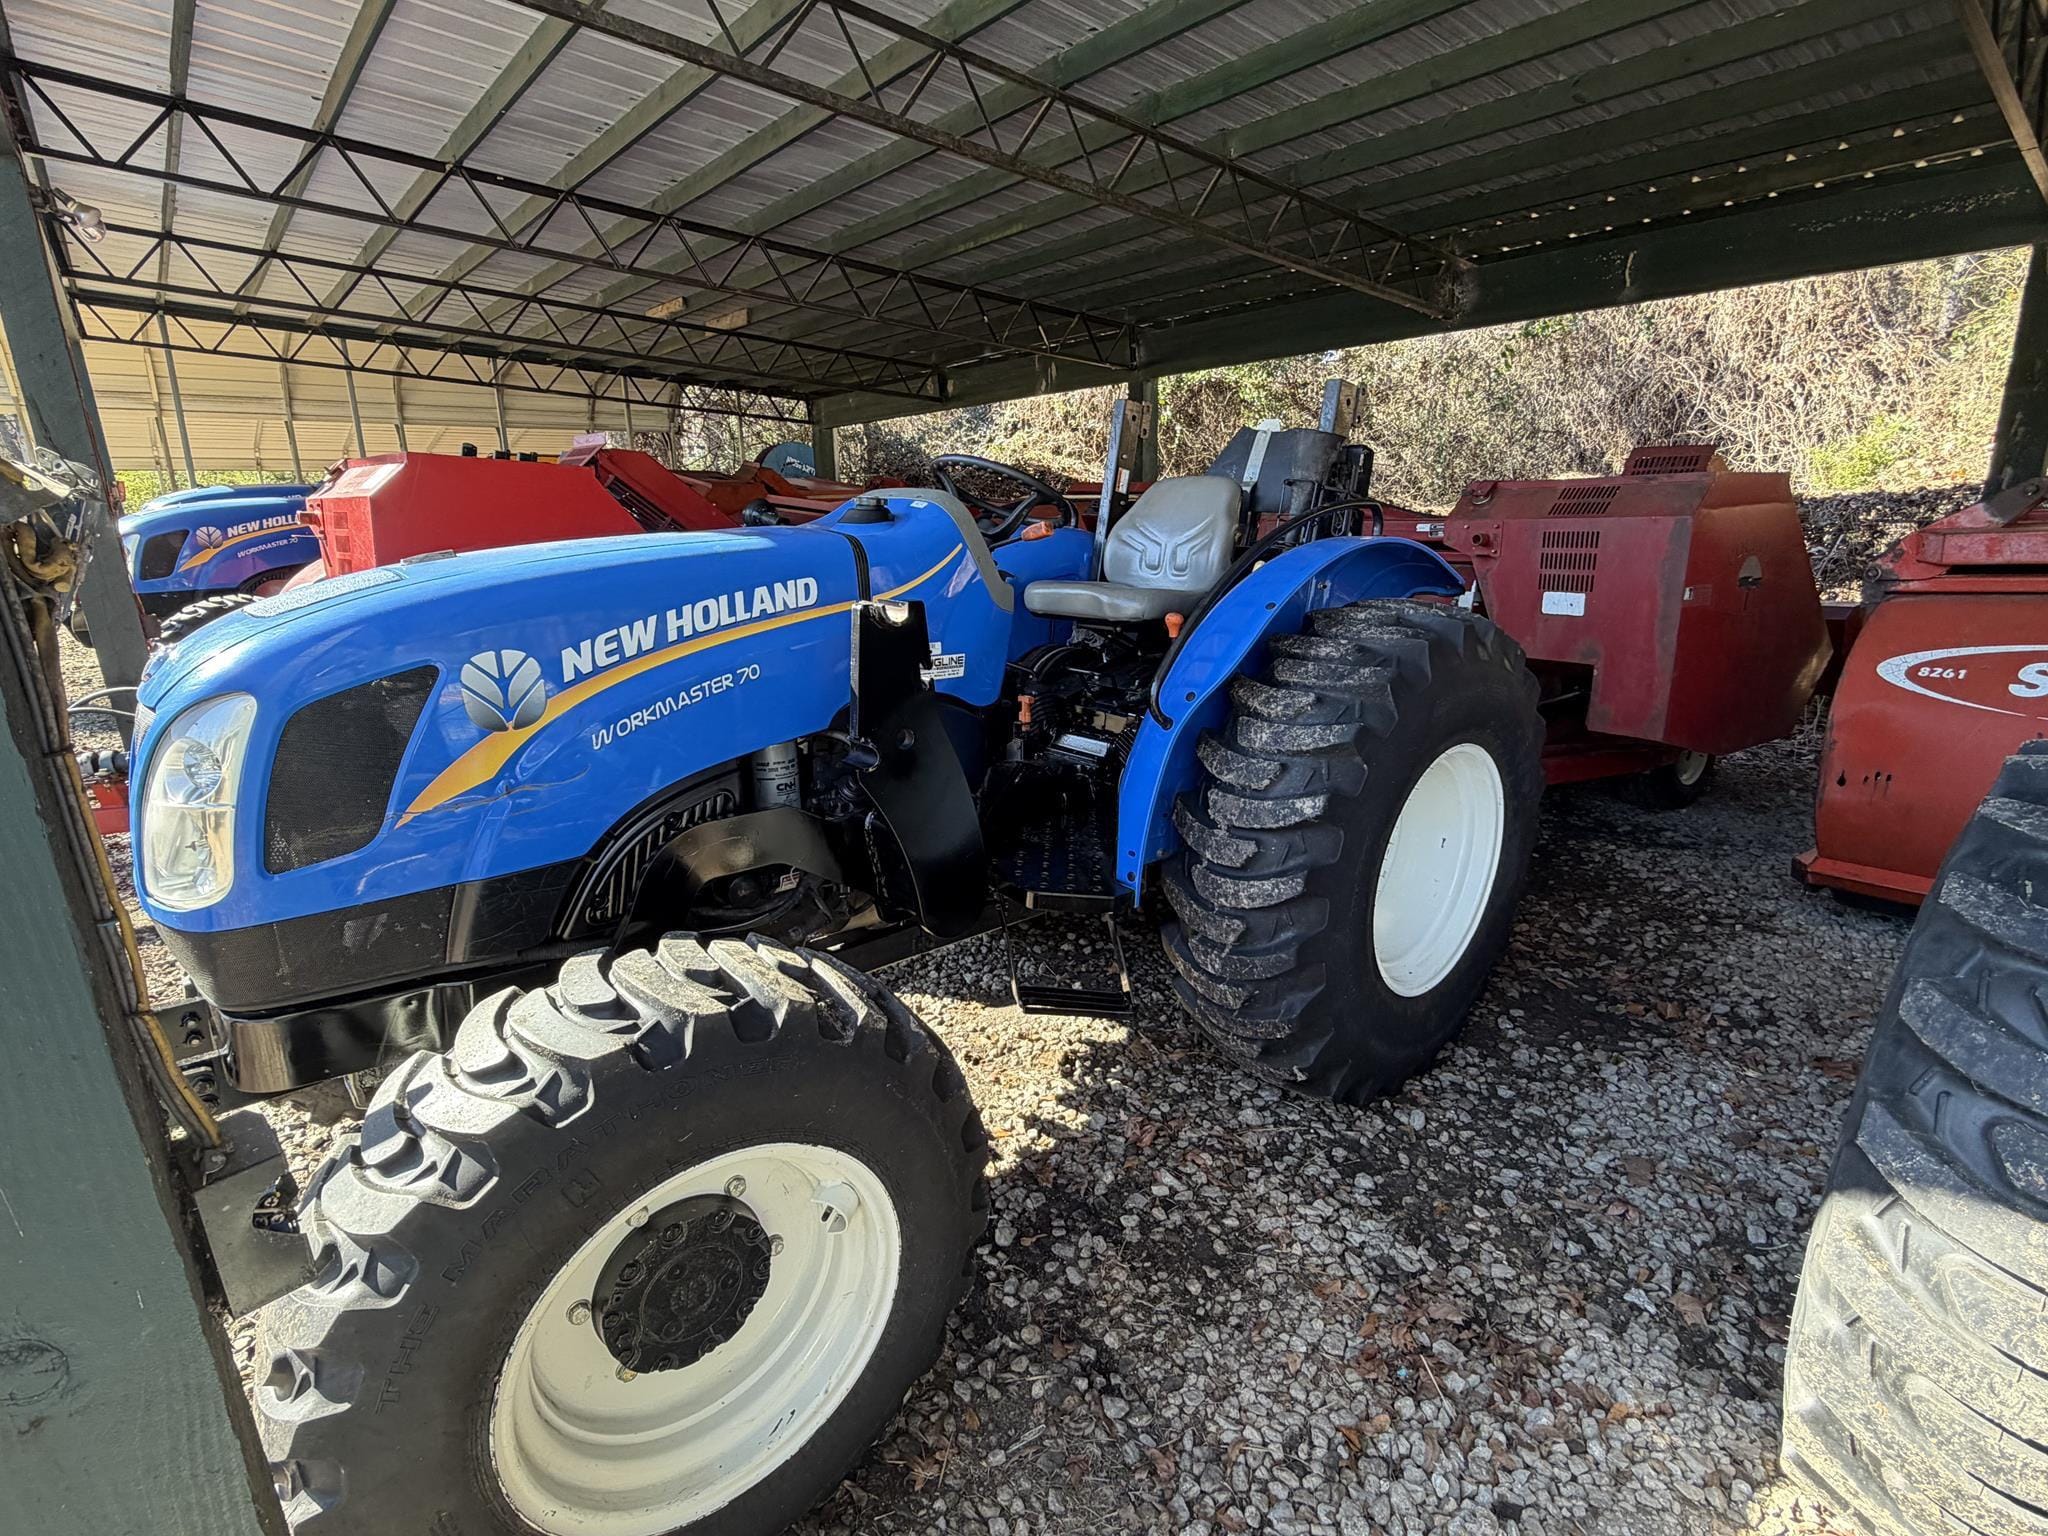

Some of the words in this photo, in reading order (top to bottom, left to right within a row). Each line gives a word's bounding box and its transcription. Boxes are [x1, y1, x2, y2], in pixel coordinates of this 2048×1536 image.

[227, 520, 260, 538] NEW
[561, 615, 657, 683] NEW
[666, 576, 818, 643] HOLLAND
[1917, 667, 1968, 679] 8261
[591, 673, 734, 751] WORKMASTER
[738, 664, 760, 685] 70
